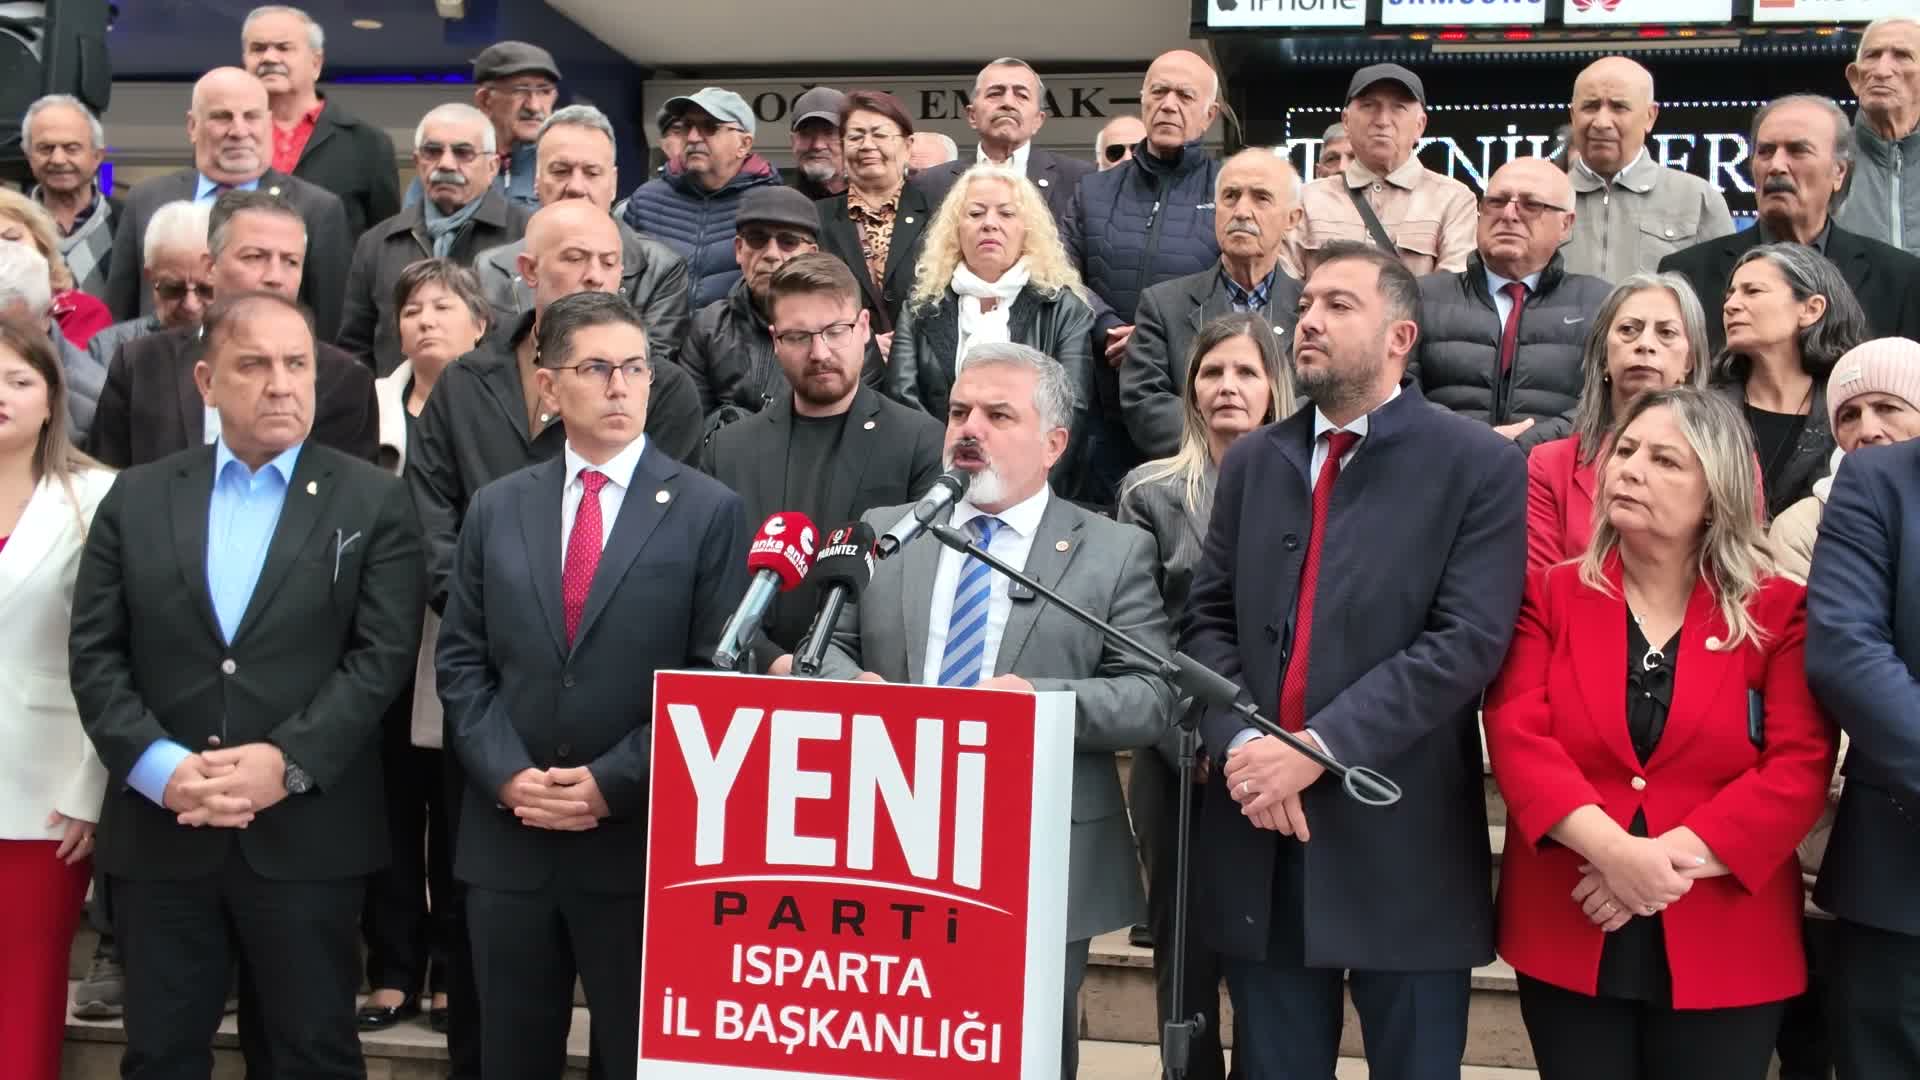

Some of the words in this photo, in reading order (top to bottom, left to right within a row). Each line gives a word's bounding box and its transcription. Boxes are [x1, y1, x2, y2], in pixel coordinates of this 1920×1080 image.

[919, 87, 1106, 120] EAK
[732, 943, 932, 999] ISPARTA
[662, 987, 701, 1038] İL
[715, 1000, 1002, 1064] BAŞKANLIĞI
